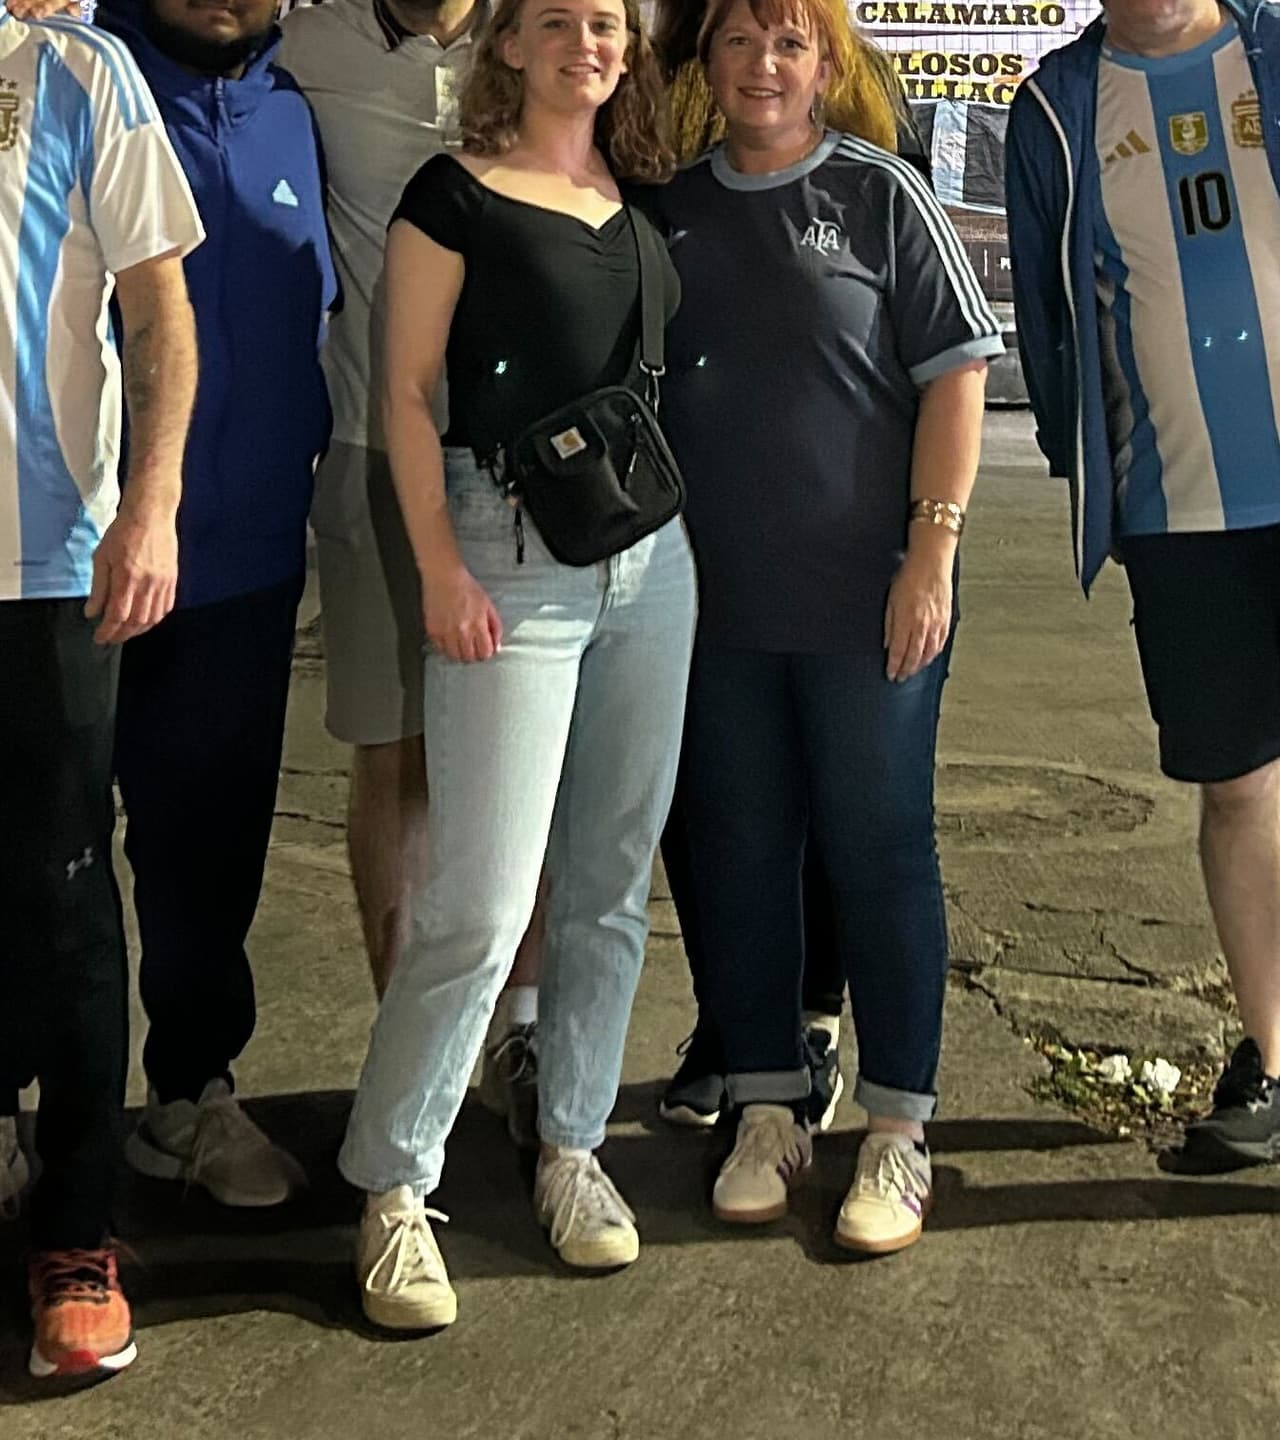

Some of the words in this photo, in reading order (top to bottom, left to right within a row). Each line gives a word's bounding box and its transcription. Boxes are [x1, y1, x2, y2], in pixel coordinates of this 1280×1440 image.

[856, 1, 1065, 26] CALAMARO
[891, 53, 1023, 76] LOSOS
[905, 79, 1014, 104] ILLAC
[1179, 172, 1232, 235] 10
